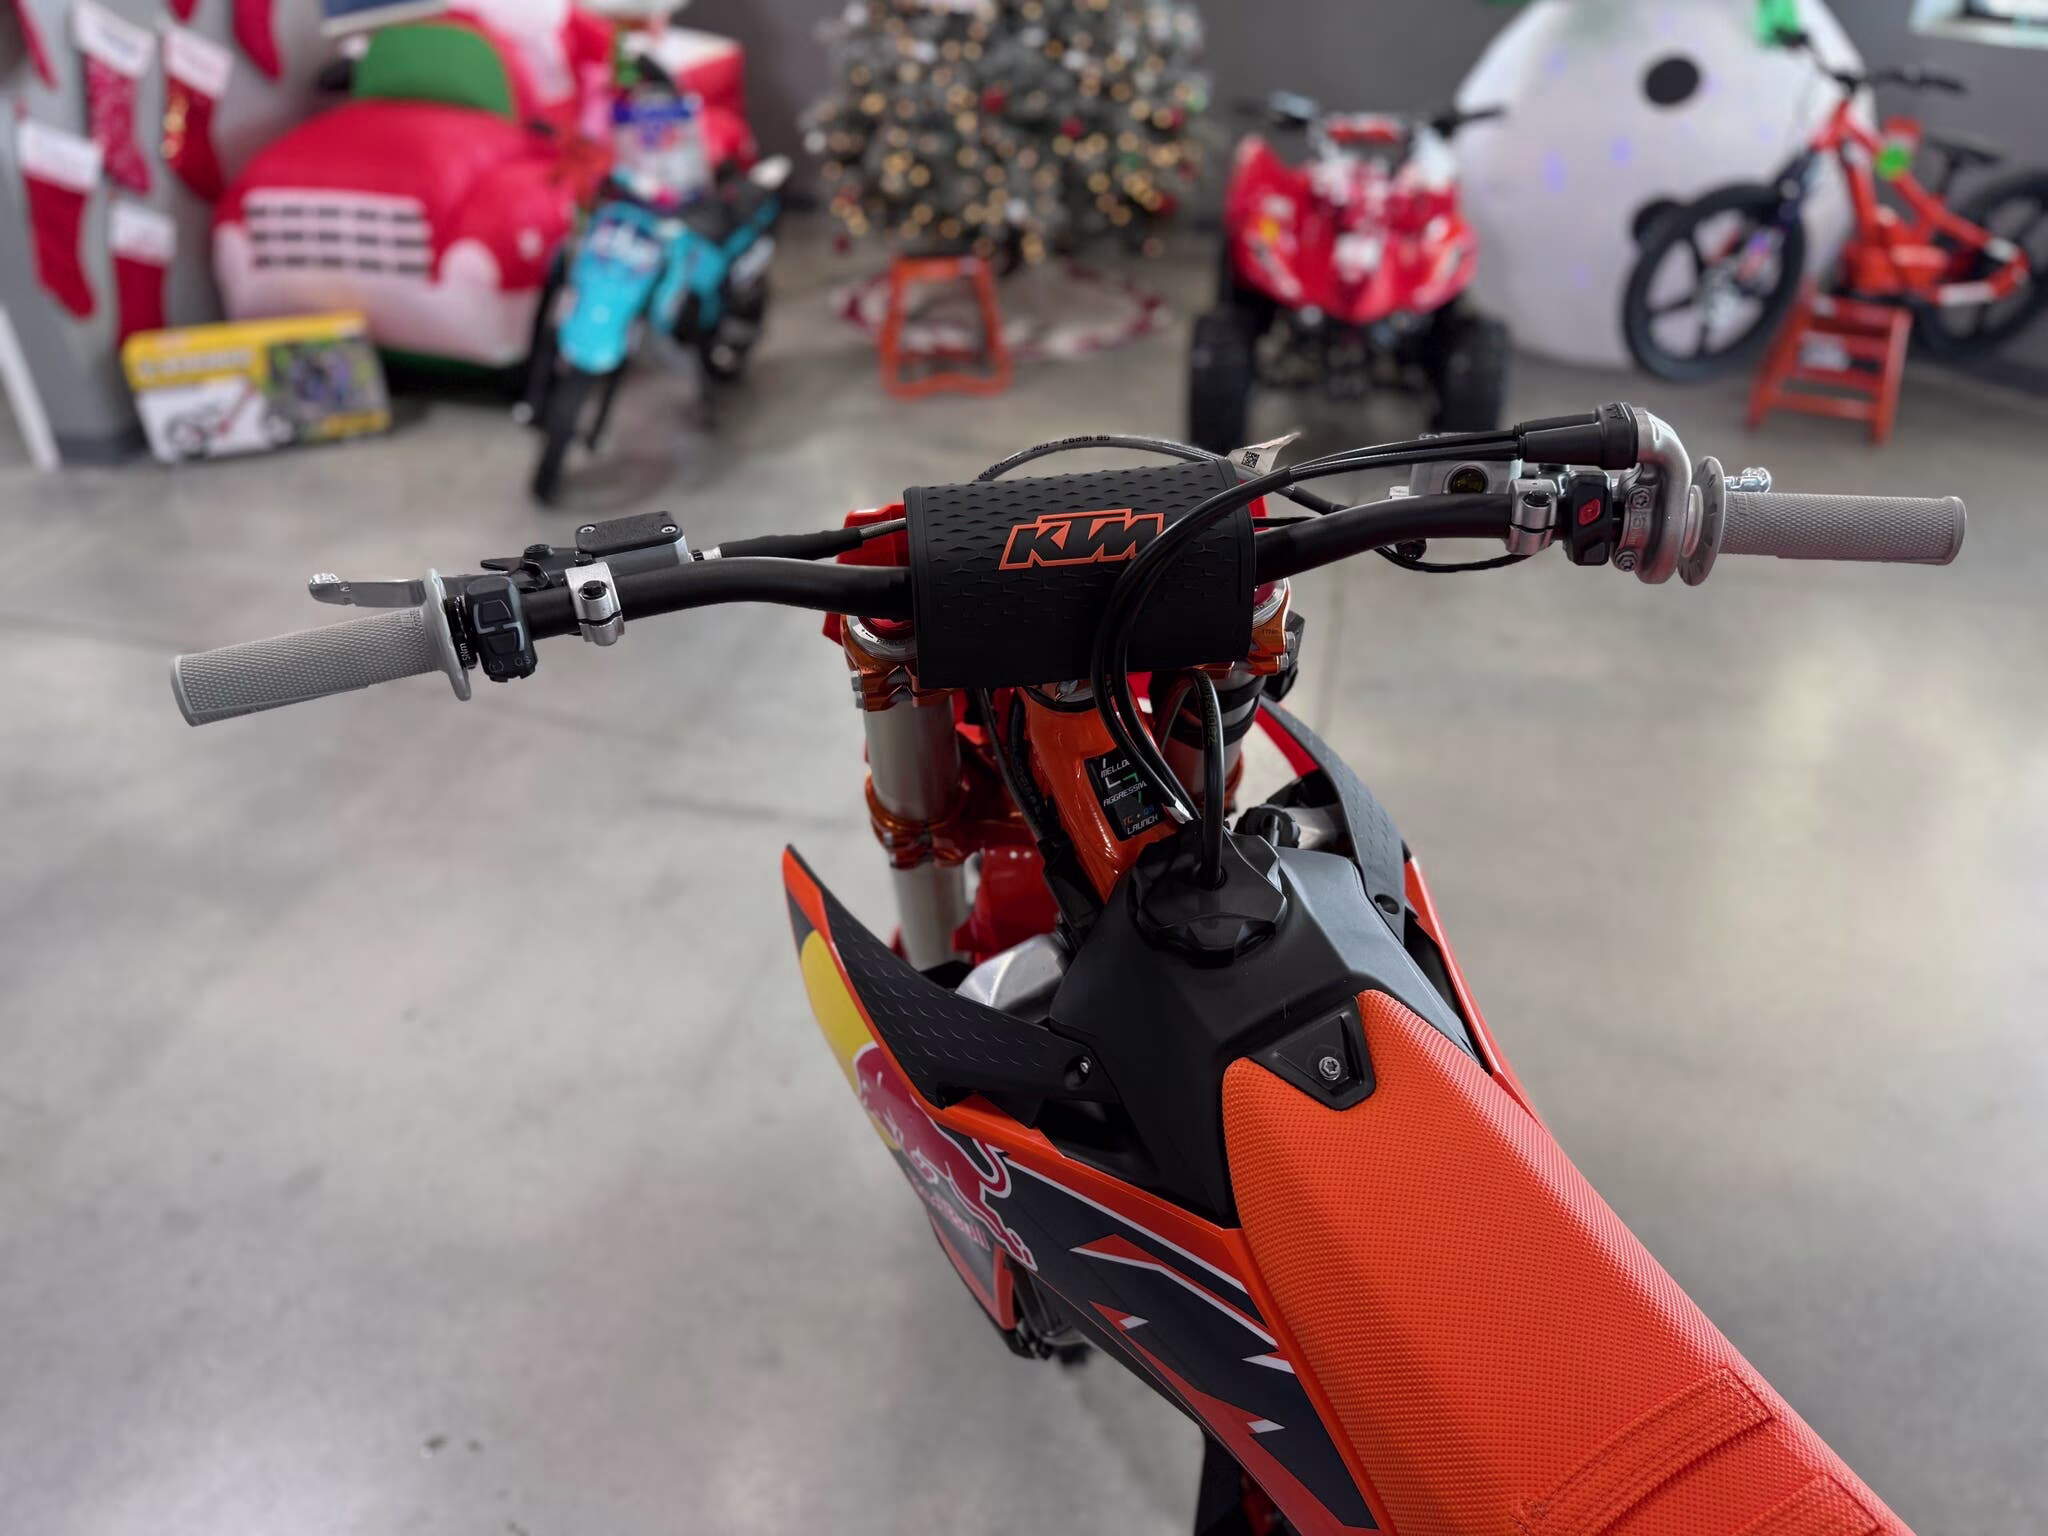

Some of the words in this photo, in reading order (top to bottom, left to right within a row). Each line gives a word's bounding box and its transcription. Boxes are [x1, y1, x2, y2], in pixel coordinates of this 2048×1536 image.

[998, 507, 1165, 571] KTM
[1101, 759, 1130, 778] MELLO
[1103, 781, 1147, 807] AGGRESSIV
[1127, 813, 1159, 835] LAUNCH
